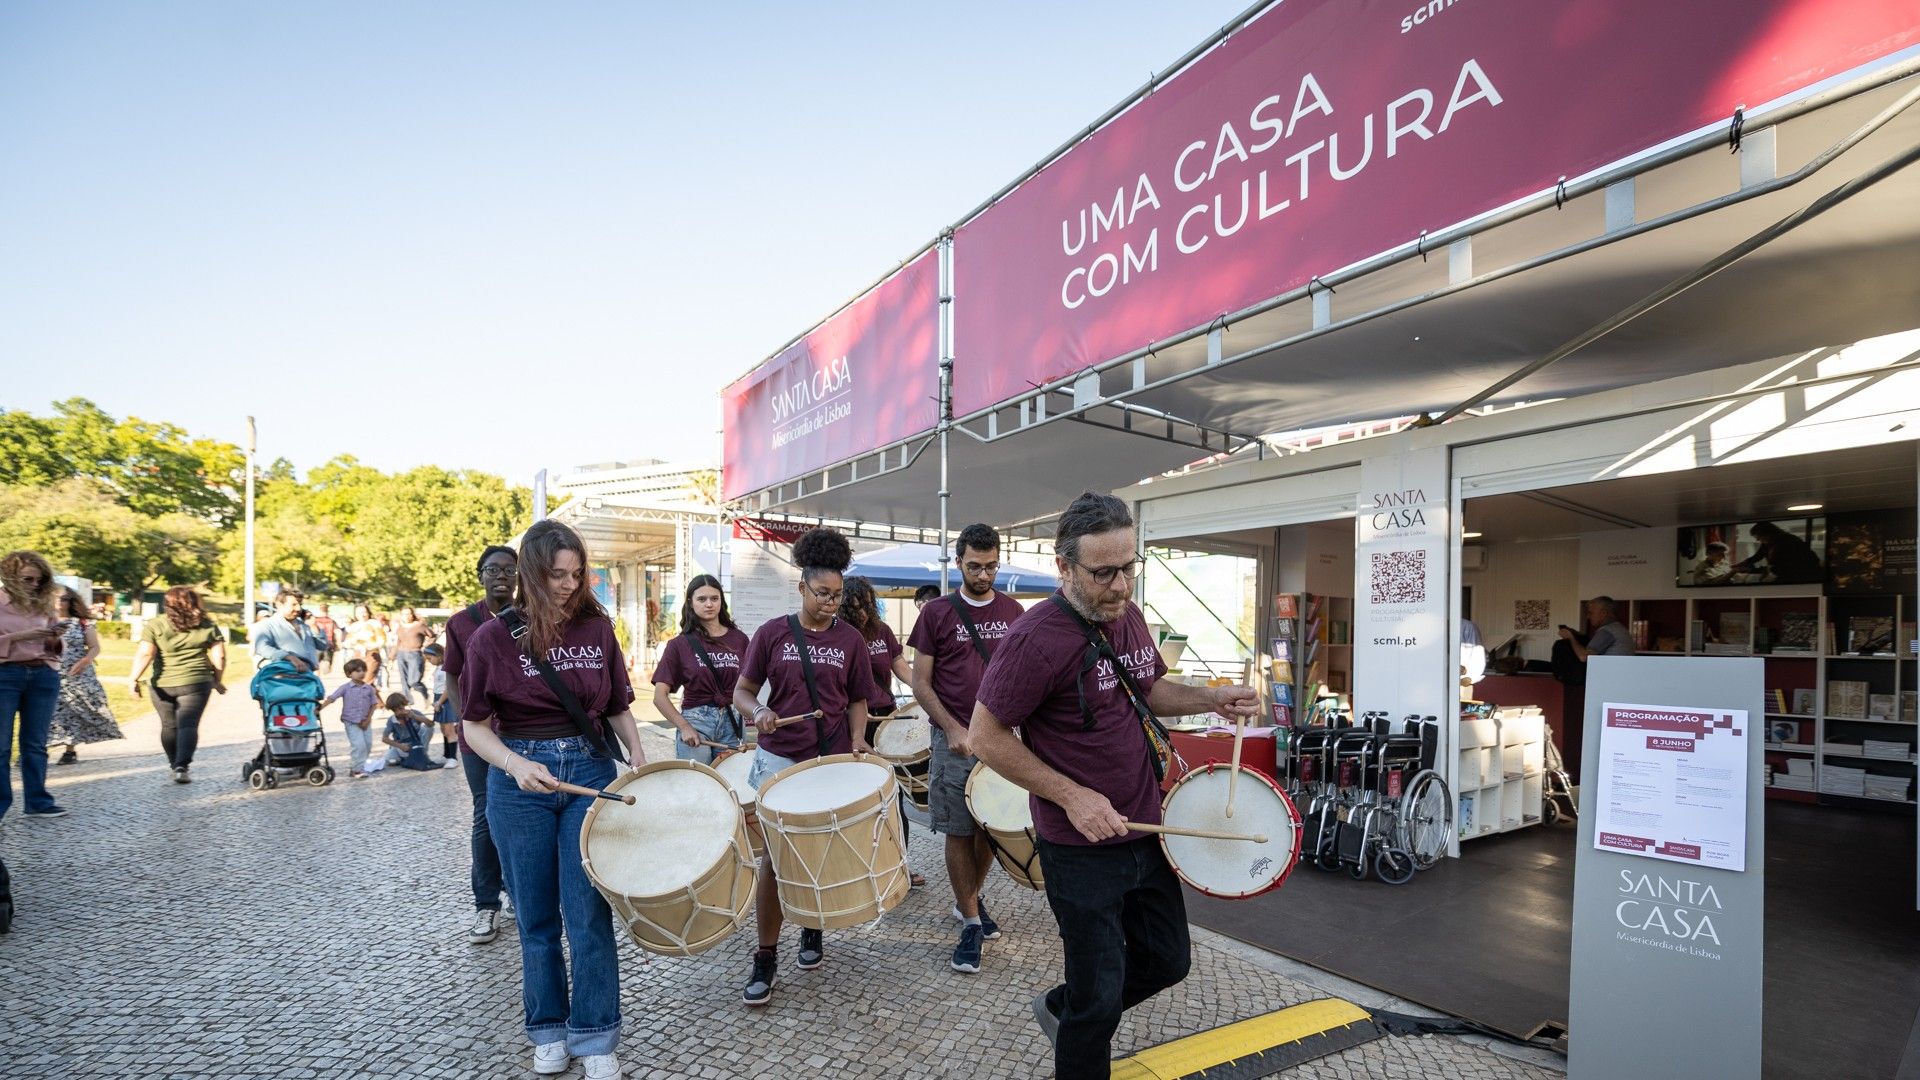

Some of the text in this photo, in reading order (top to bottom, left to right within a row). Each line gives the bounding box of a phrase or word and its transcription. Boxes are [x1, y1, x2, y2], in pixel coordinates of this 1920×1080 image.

[1400, 0, 1459, 34] scm
[1062, 72, 1334, 256] UMA CASA
[1061, 57, 1504, 310] COM CULTURA
[771, 355, 852, 424] SANTA CASA
[813, 410, 824, 430] de
[824, 401, 851, 425] Lisboa
[1373, 488, 1427, 509] SANTA
[1372, 508, 1427, 531] CASA
[984, 621, 1009, 631] CASA
[1373, 636, 1417, 647] scml.pt
[569, 645, 603, 659] CASA
[716, 652, 740, 662] CASA
[818, 647, 846, 661] CASA
[575, 661, 584, 669] de
[584, 659, 604, 670] Lisbo
[818, 656, 826, 665] de
[827, 657, 844, 669] Lisboa
[1136, 668, 1146, 679] de
[1615, 711, 1700, 724] PROGRAMAÇÃO
[1659, 739, 1692, 748] JUNHO
[1617, 841, 1644, 850] CULTURA
[1618, 869, 1722, 909] SANTA
[1616, 900, 1721, 946] CASA
[1616, 931, 1721, 961] Misericórdia de Lisboa
